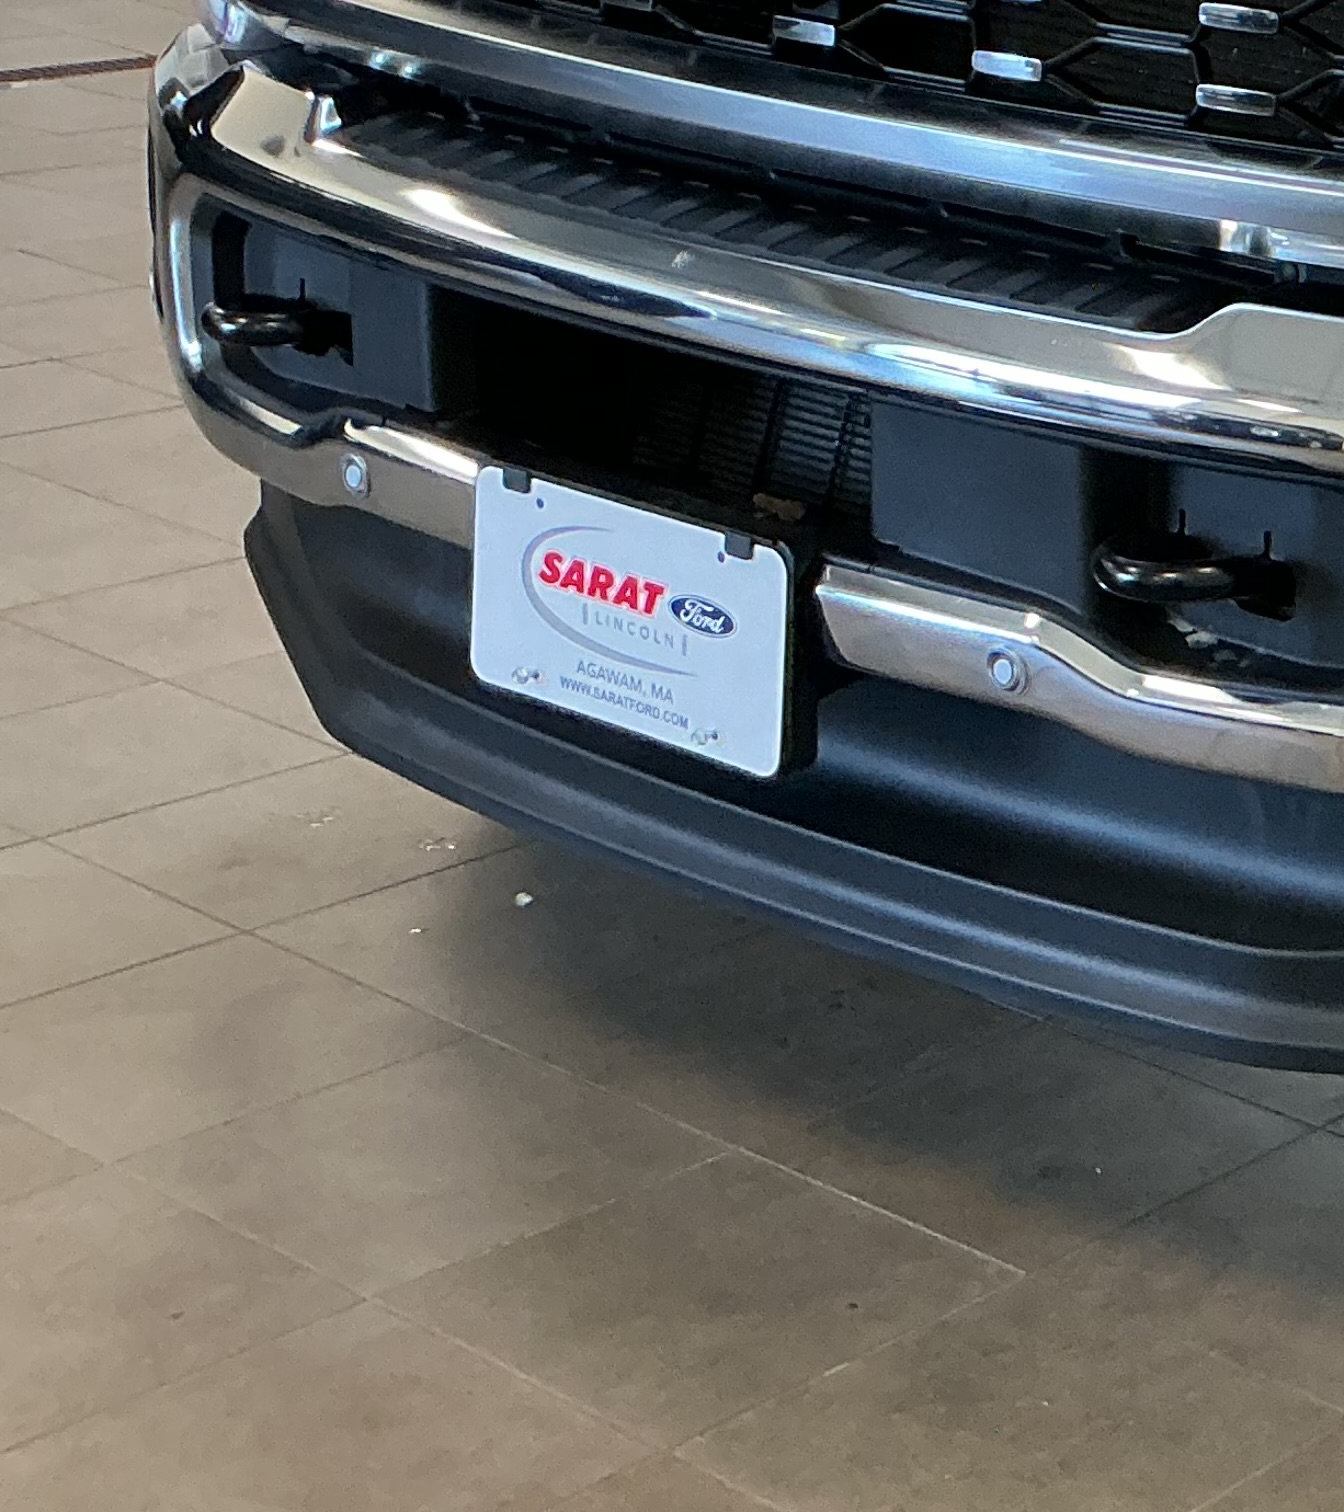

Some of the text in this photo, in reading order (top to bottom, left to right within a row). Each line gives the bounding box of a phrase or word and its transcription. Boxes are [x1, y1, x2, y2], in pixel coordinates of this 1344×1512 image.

[537, 548, 727, 635] SARAT Ford
[595, 611, 675, 649] LINCOLN
[559, 675, 689, 729] WWW.SARATFORD.COM
[576, 660, 674, 705] AGAWAM, MA
